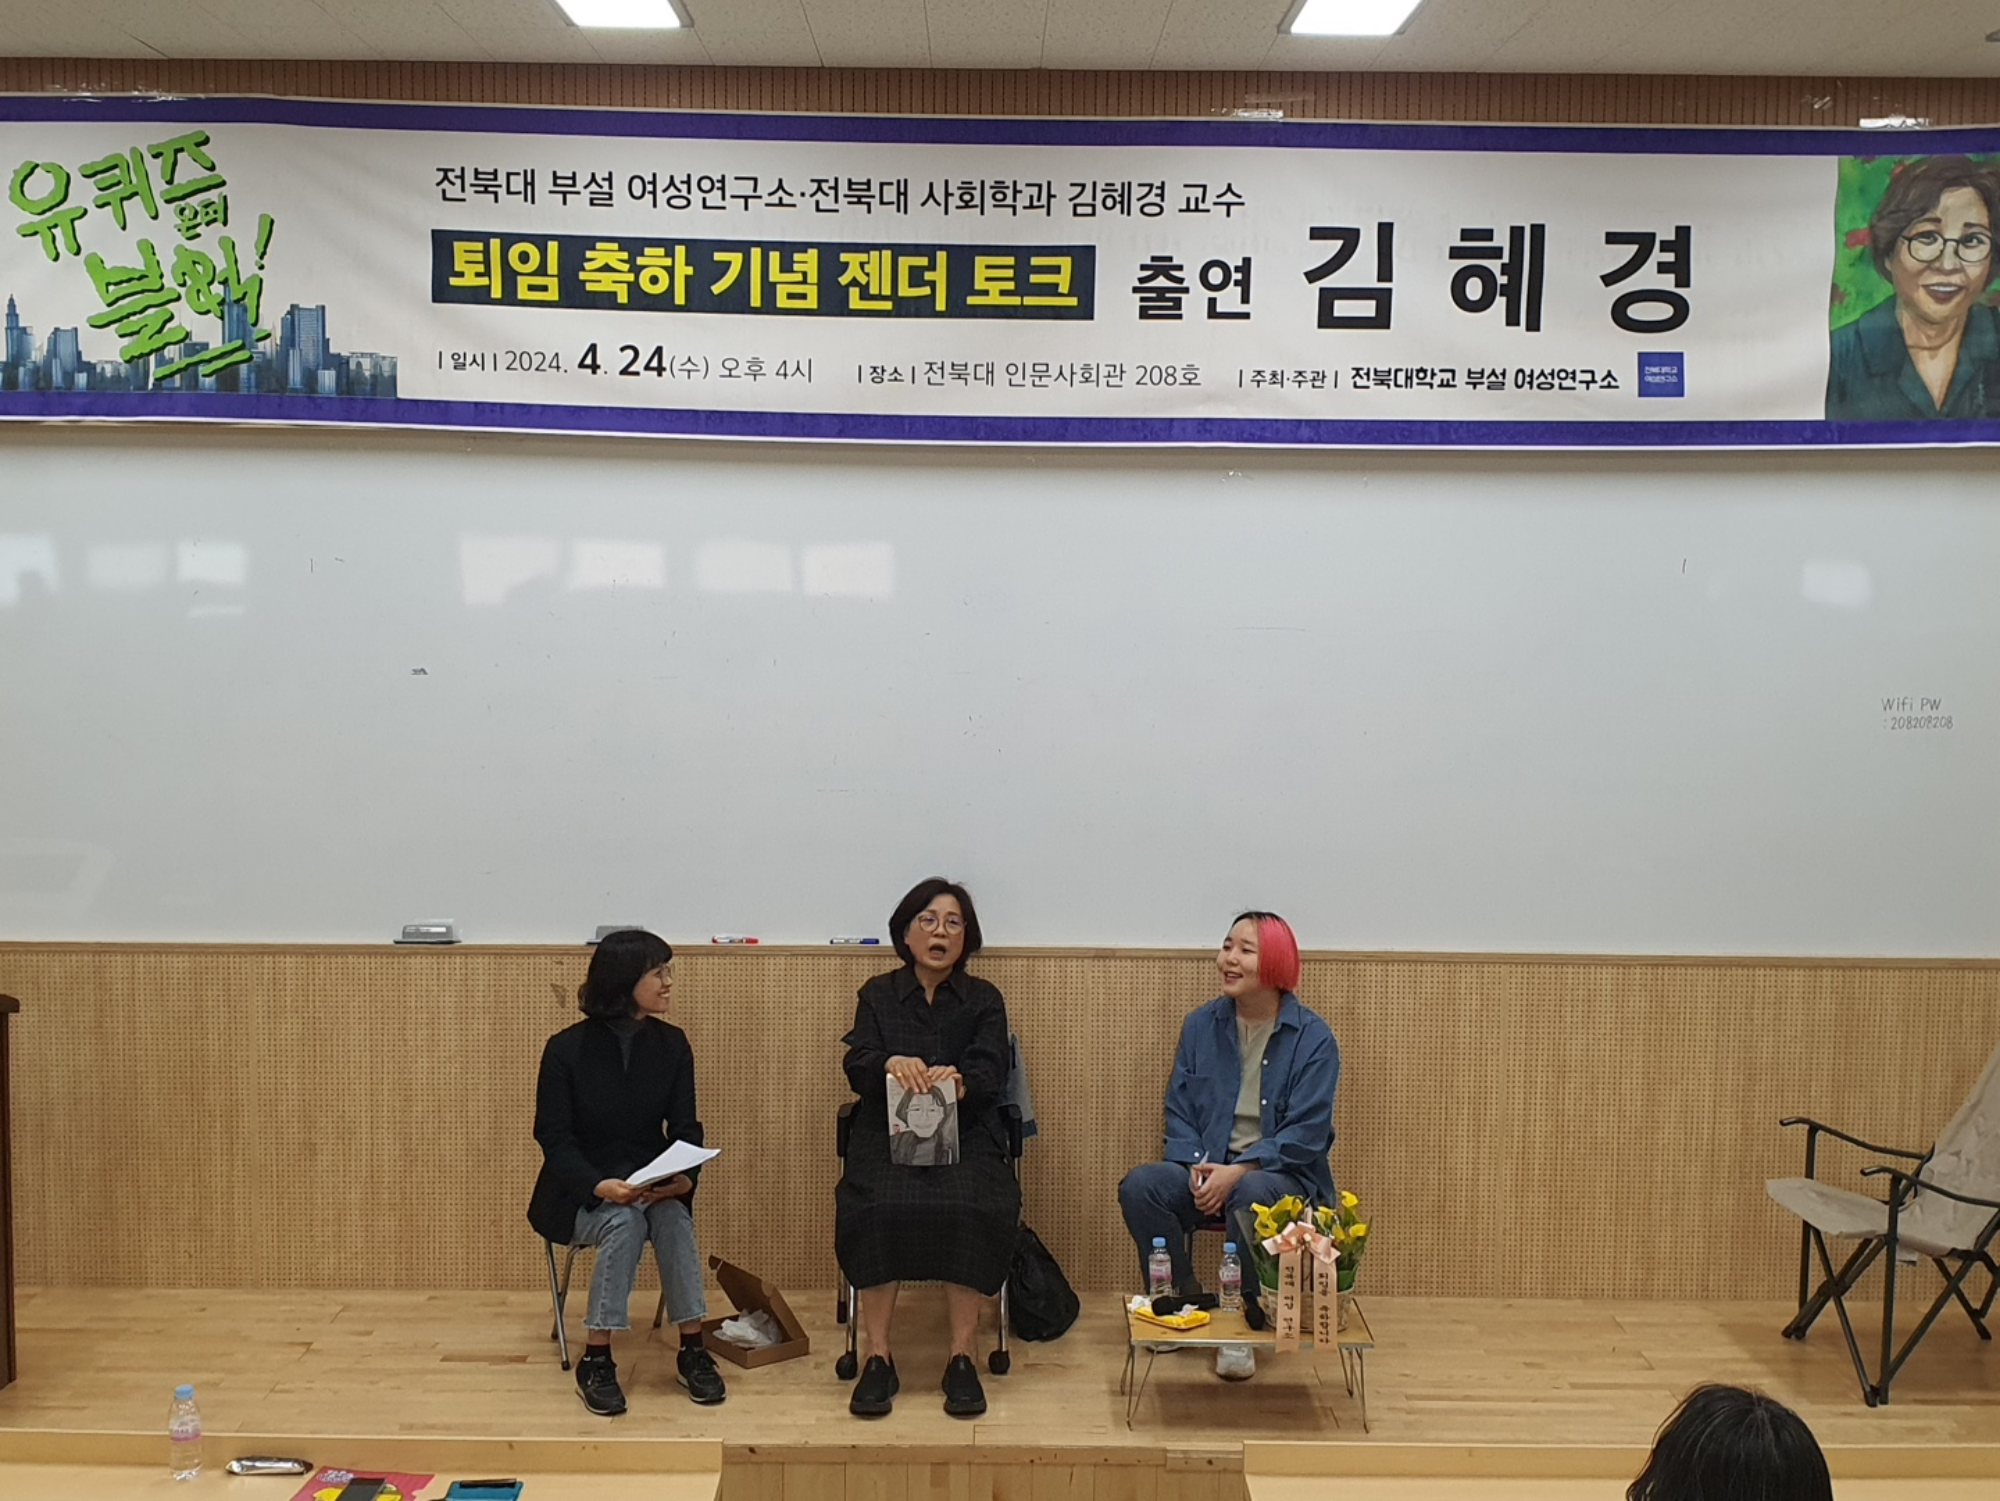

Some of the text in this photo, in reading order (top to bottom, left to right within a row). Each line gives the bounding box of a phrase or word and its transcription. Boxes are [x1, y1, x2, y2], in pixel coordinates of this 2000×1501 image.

[9, 130, 226, 261] 유퀴즈
[435, 165, 536, 205] 전북대
[547, 169, 614, 208] 부설
[920, 178, 1058, 218] 사회학과
[1067, 180, 1166, 218] 김혜경
[1177, 182, 1246, 219] 교수
[449, 238, 1079, 312] 퇴임 축하 기념 젠더 토크
[1131, 254, 1252, 321] 출연
[504, 349, 568, 374] 2024.
[718, 356, 767, 383] 오후
[775, 357, 812, 384] 4시
[923, 360, 995, 388] 전북대
[1005, 361, 1127, 389] 인문사회관
[1135, 363, 1202, 387] 208호
[1350, 365, 1458, 391] 전북대학교
[1464, 367, 1507, 391] 부설
[1513, 367, 1620, 391] 여성연구소
[1881, 696, 1942, 713] Wifi PW
